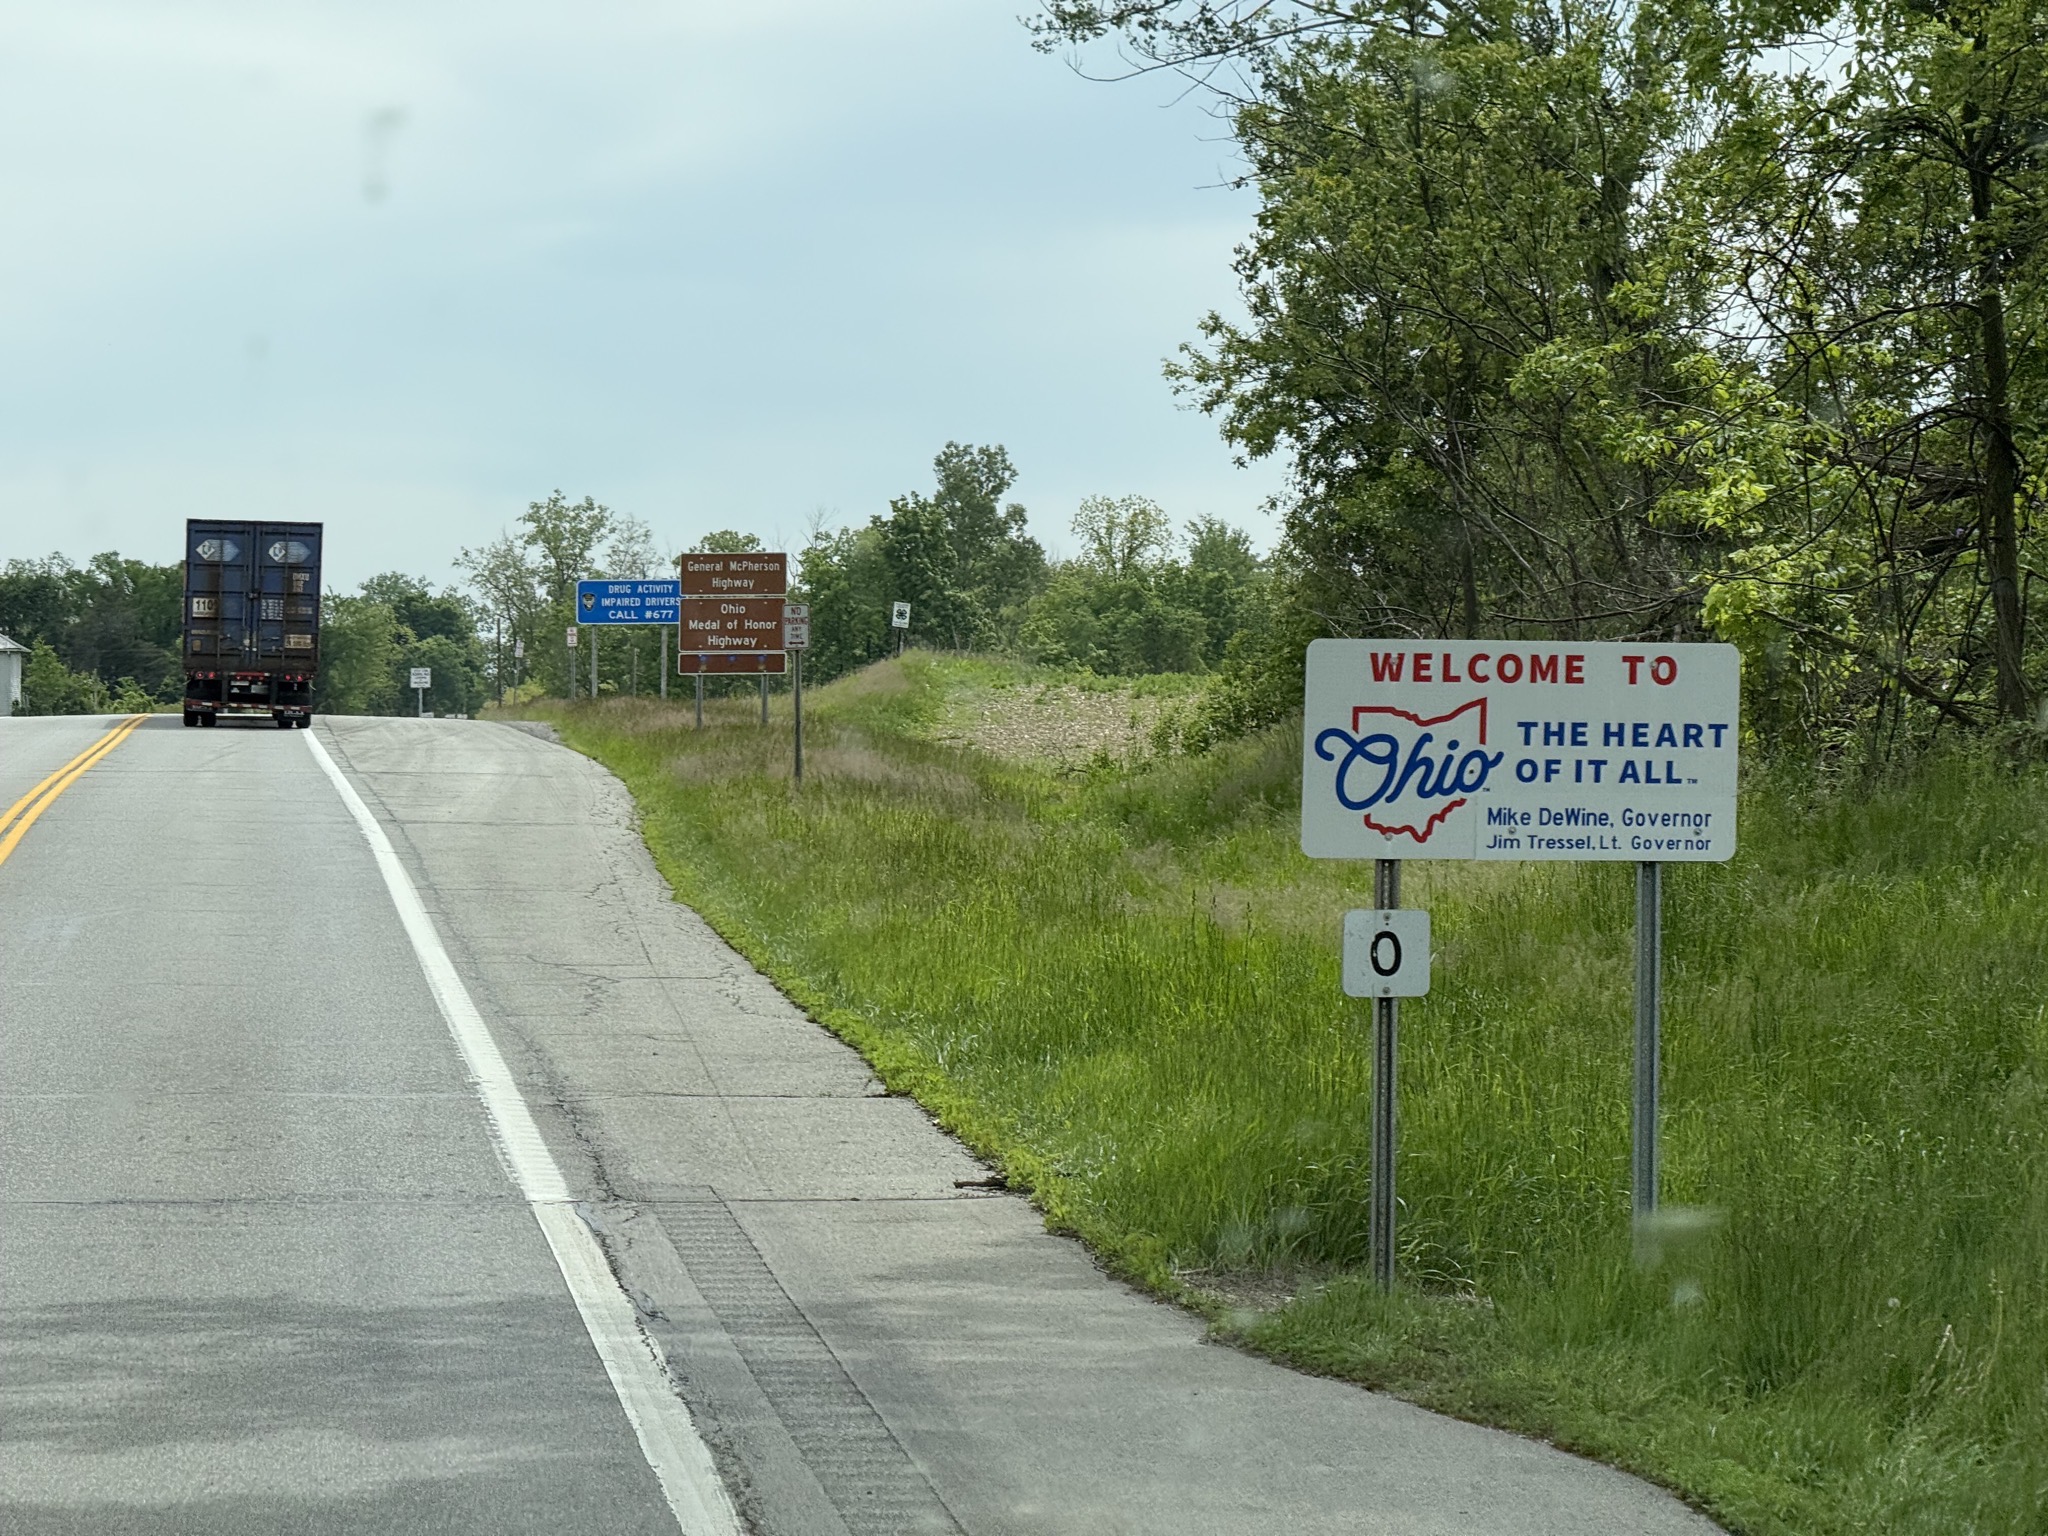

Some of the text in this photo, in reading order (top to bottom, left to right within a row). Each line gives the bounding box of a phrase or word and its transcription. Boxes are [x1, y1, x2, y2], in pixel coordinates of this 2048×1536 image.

[688, 561, 780, 572] General McPherson
[608, 584, 674, 594] DRUG ACTIVITY
[712, 577, 755, 591] Highway
[602, 597, 680, 606] IMPAIRED DRIVERS
[608, 610, 674, 620] CALL #677
[720, 604, 746, 614] Ohio
[791, 607, 802, 616] NO
[688, 620, 777, 630] Medal of Honor
[708, 635, 757, 648] Highway
[1370, 652, 1677, 685] WELCOME TO
[1517, 721, 1729, 748] THE HEART
[1314, 728, 1504, 810] Ohio
[1516, 758, 1562, 784] OF
[1574, 760, 1608, 784] IT
[1618, 760, 1682, 784] ALL
[1487, 807, 1712, 828] Mike DeWine, Governor
[1486, 835, 1712, 850] Jim Tressel, Lt. Governor
[1370, 930, 1402, 976] 0
